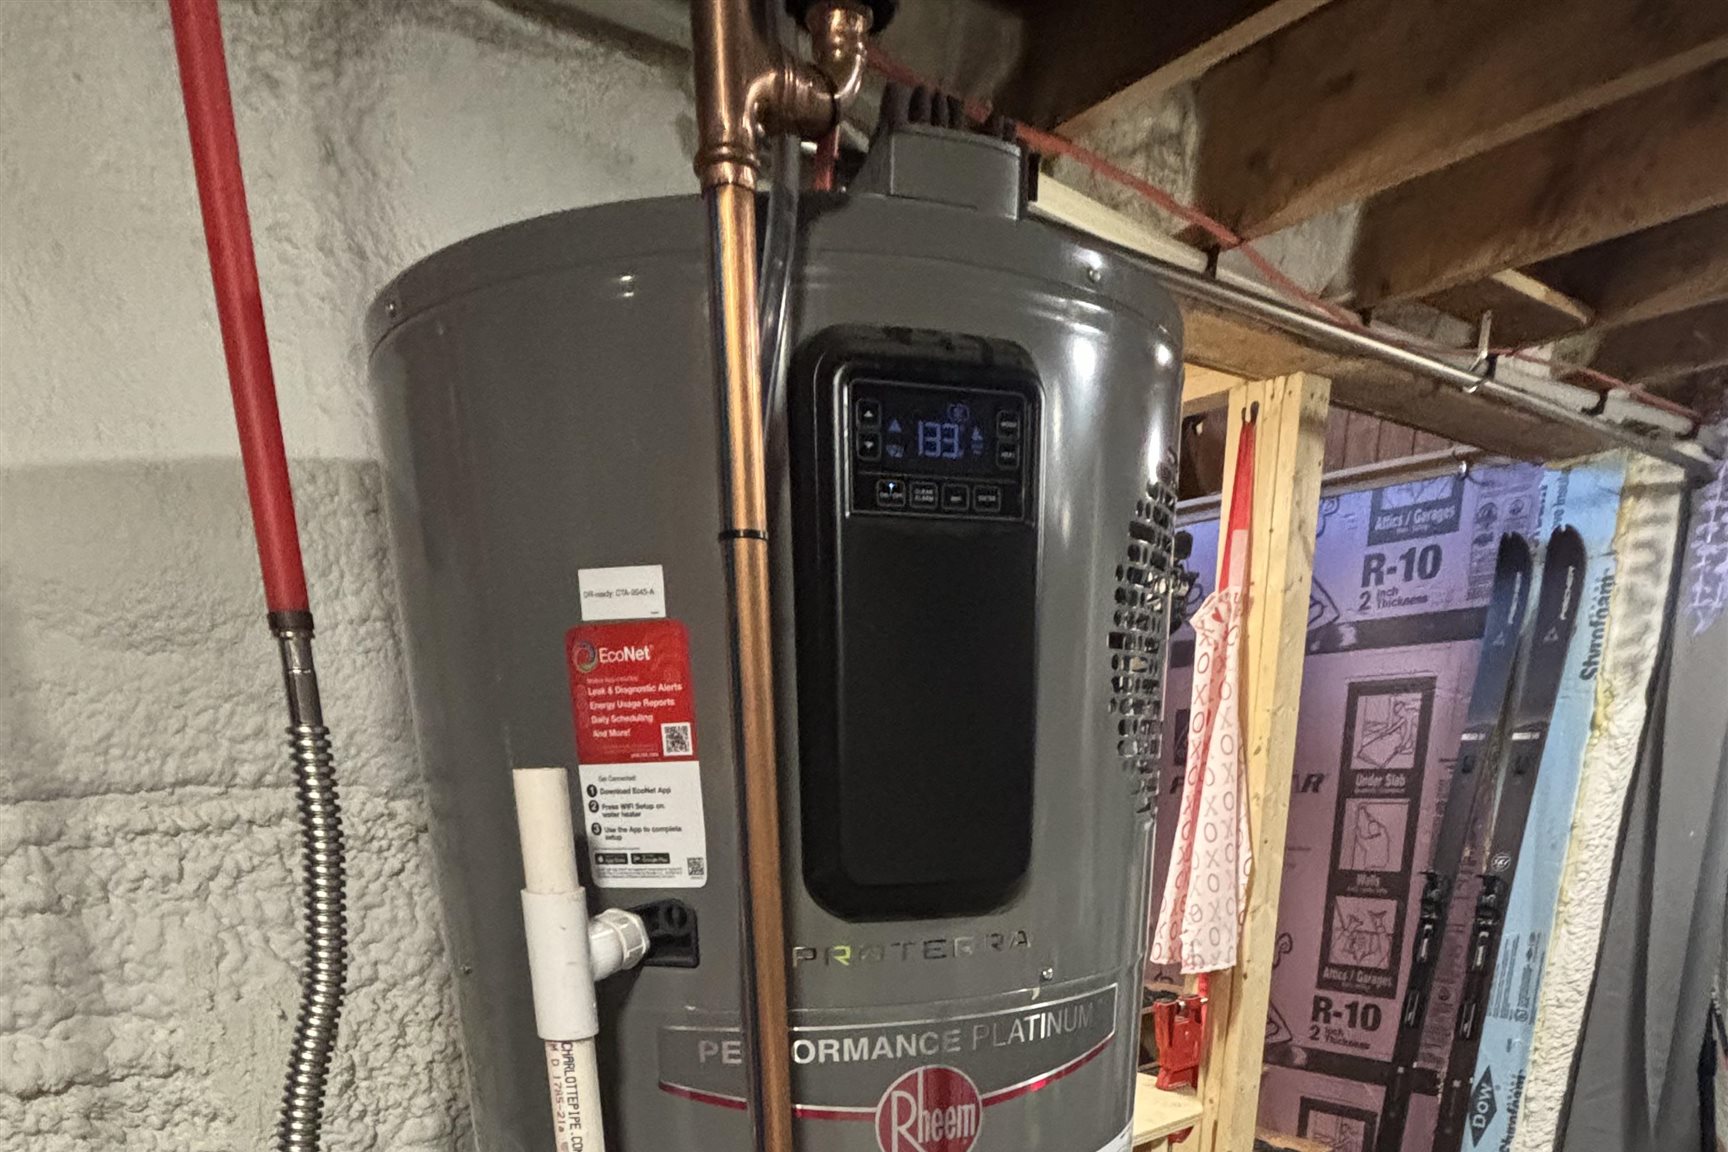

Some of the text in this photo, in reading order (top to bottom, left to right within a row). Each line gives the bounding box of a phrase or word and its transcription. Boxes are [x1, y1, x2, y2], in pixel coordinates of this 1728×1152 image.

[1360, 544, 1443, 589] R-10
[1358, 591, 1372, 611] 2
[598, 645, 651, 665] EcoNet
[587, 687, 606, 696] Leak
[615, 684, 657, 695] Diagnostic
[658, 683, 683, 692] Alerts
[589, 698, 675, 711] Energy Usage Reports
[591, 714, 654, 725] Daily Scheduling
[592, 729, 608, 738] And
[1384, 772, 1406, 787] Slab
[600, 787, 631, 795] Download
[657, 786, 671, 794] App
[651, 825, 682, 834] complete
[791, 929, 1034, 968] PROTERRA
[1312, 994, 1382, 1032] R-10
[700, 1002, 1094, 1066] PEORMANCE PLATINUM
[1309, 1024, 1320, 1041] 2
[1472, 1083, 1492, 1129] DOW
